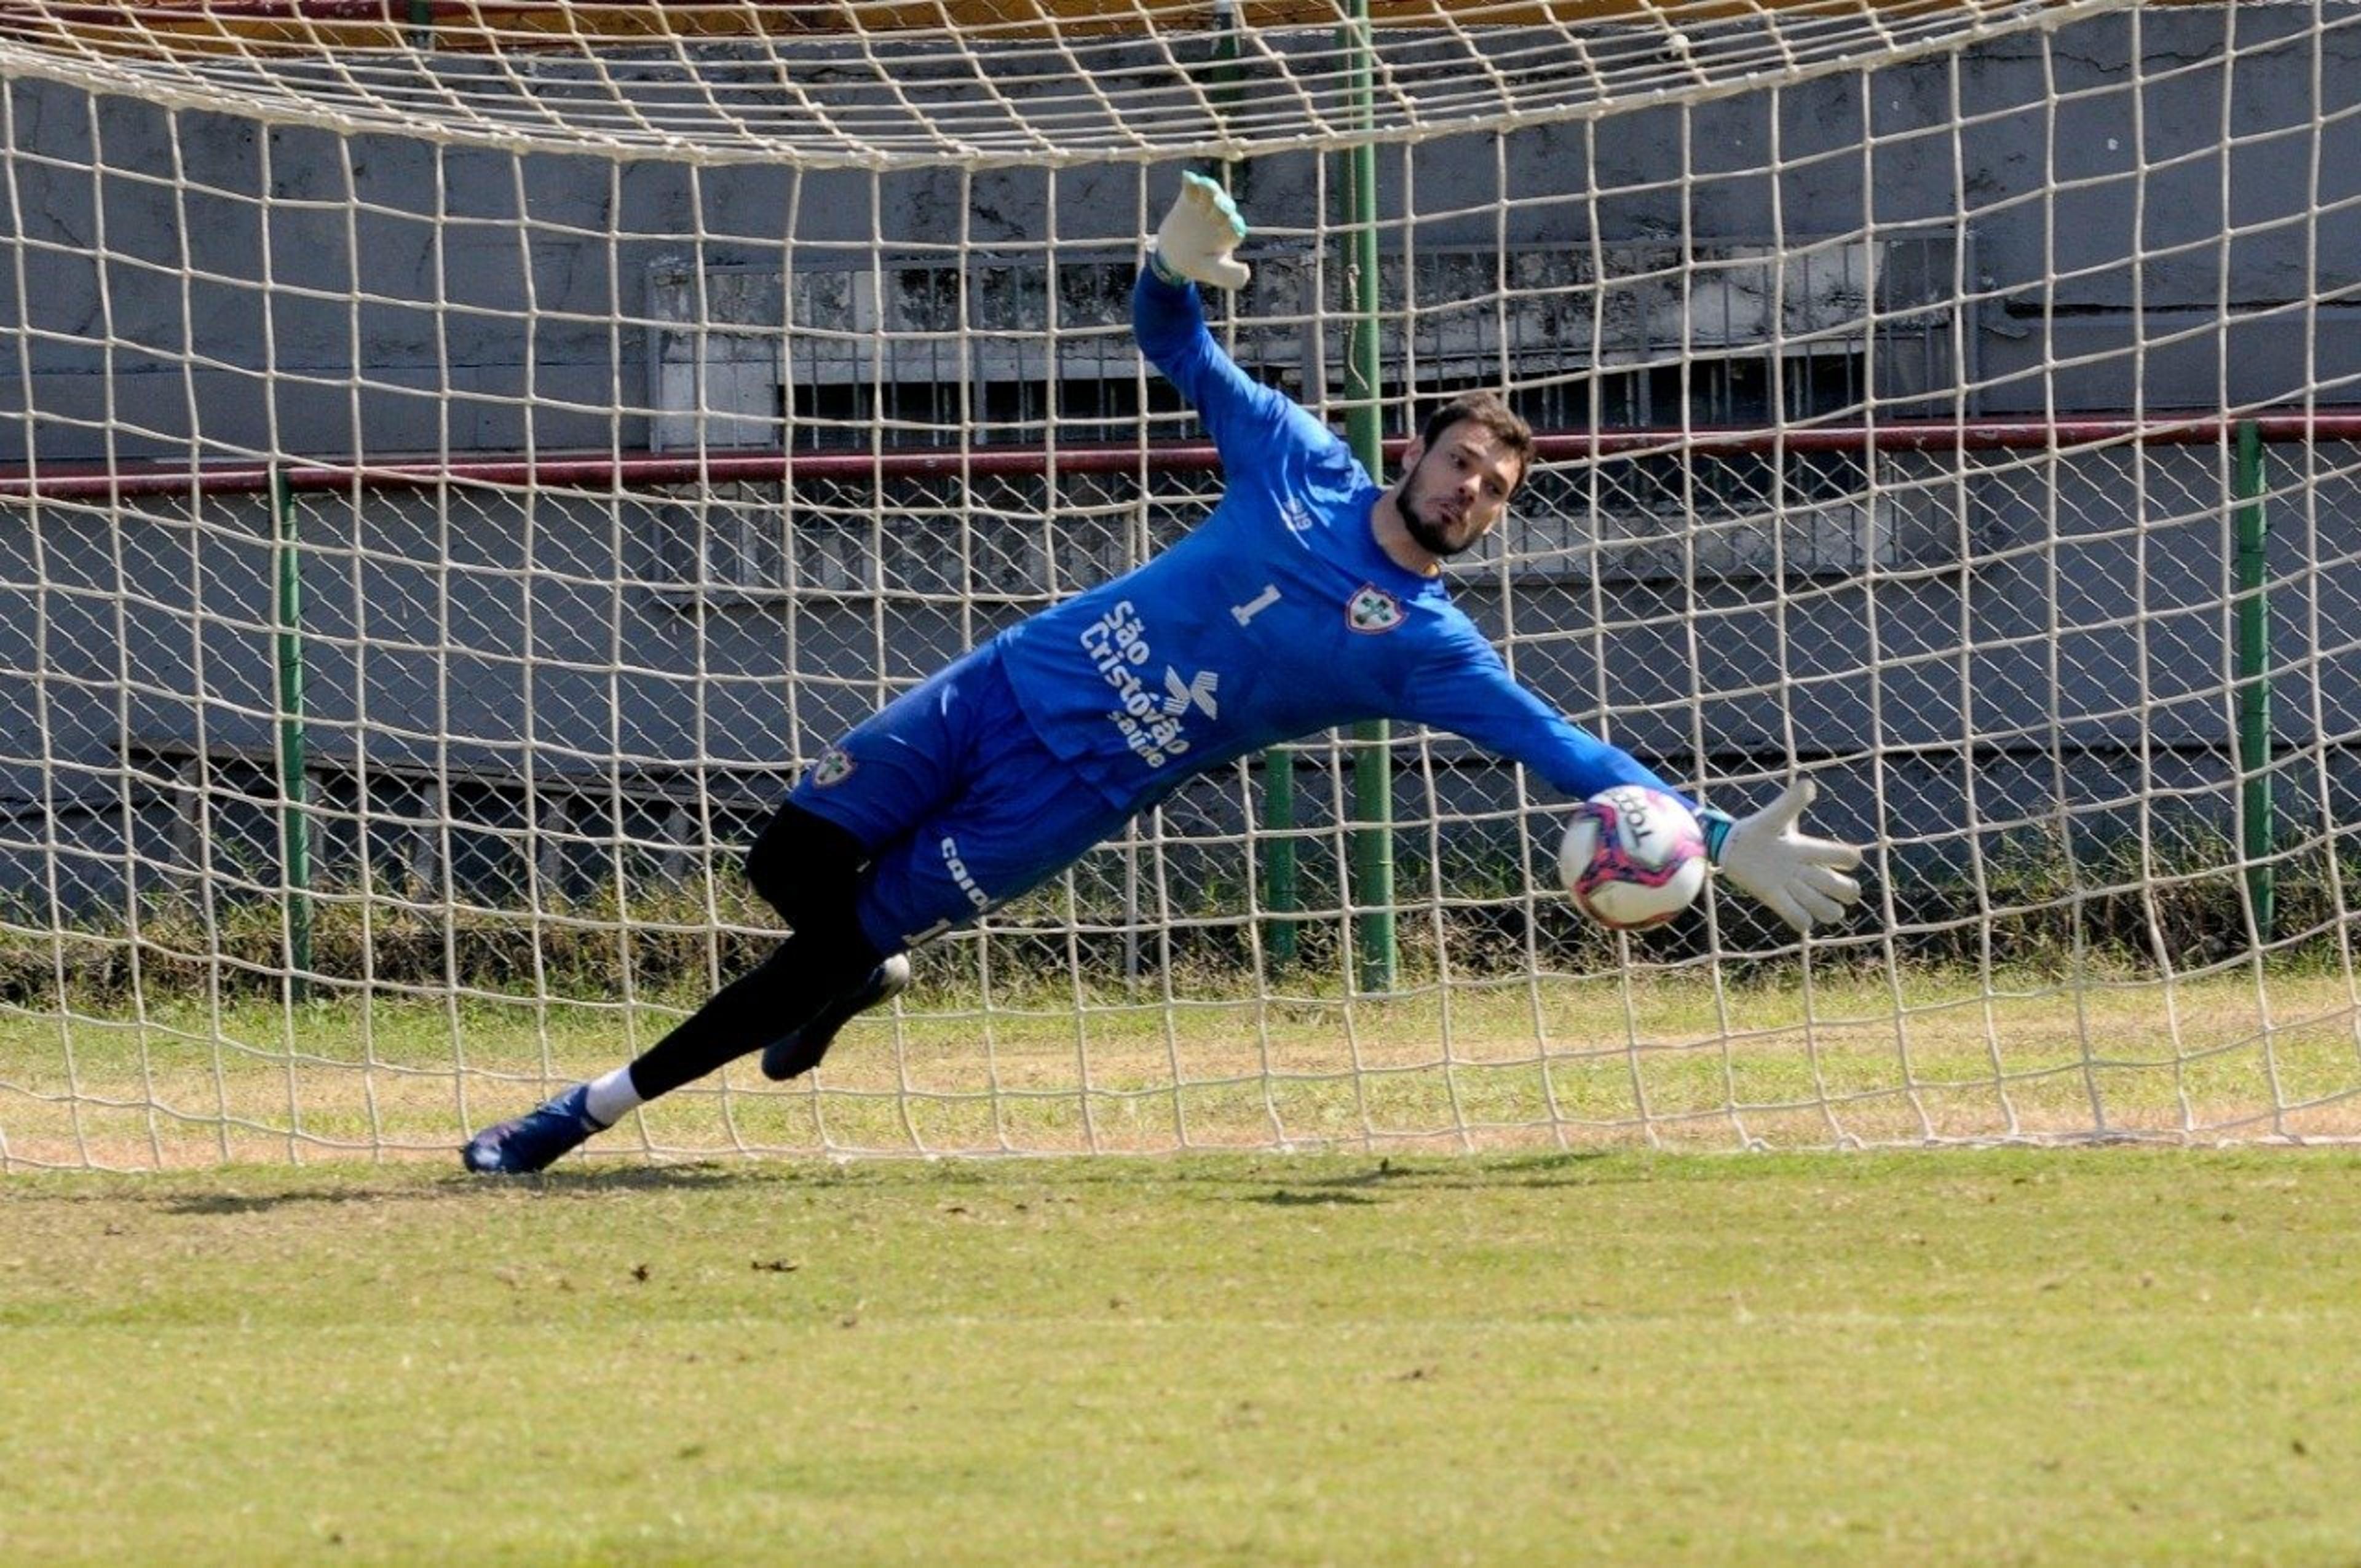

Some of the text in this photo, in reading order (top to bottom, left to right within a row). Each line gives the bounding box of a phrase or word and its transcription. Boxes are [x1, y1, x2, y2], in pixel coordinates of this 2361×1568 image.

[1104, 601, 1150, 665] São
[1231, 585, 1281, 626] 1
[1080, 621, 1190, 754] Cristóvão
